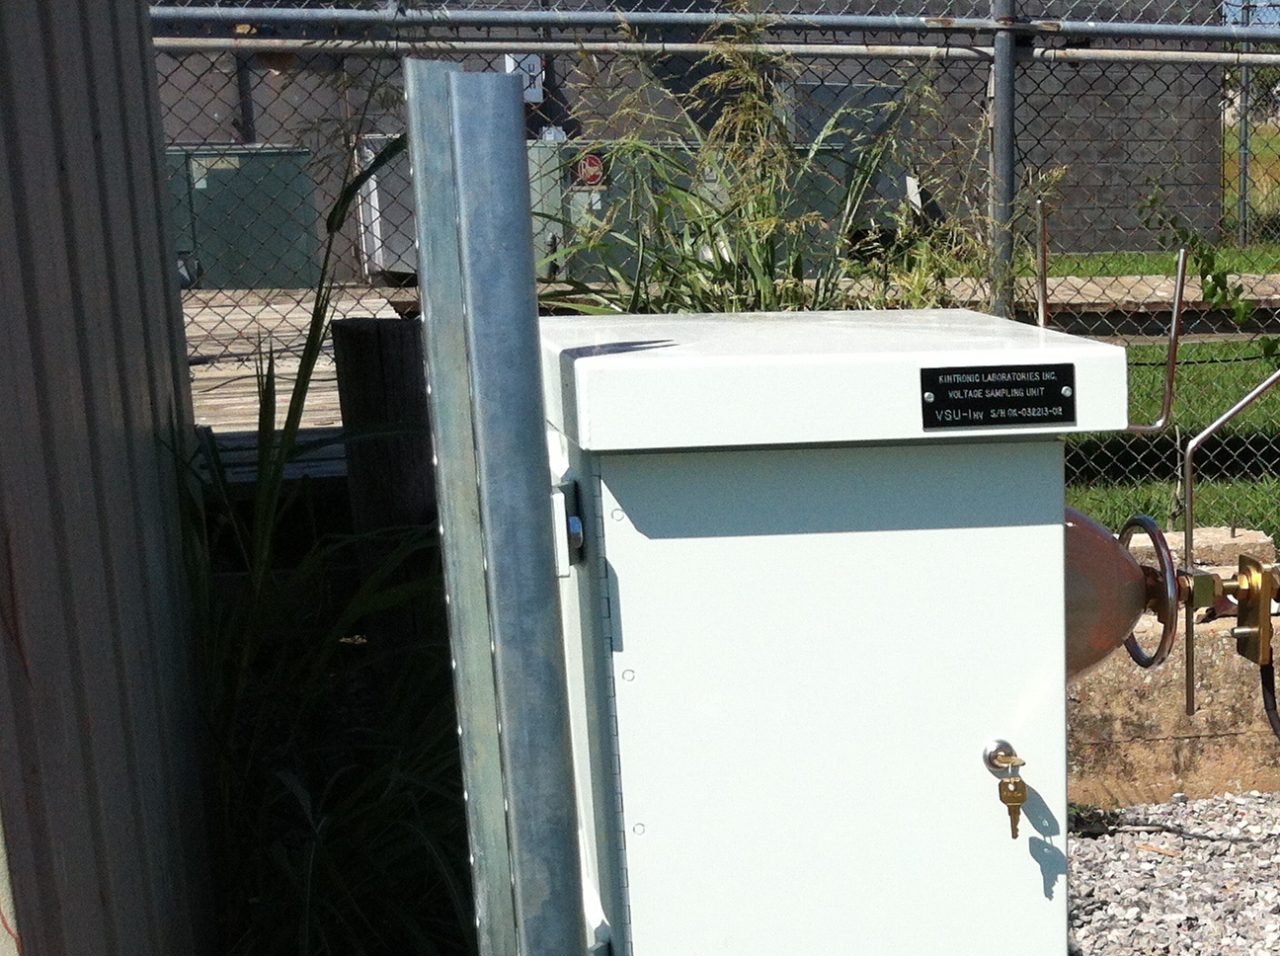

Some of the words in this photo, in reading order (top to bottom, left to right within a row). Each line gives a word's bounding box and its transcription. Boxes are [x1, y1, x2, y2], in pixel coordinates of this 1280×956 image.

[938, 374, 980, 384] KINTRONIC
[982, 372, 1040, 383] LABORATORIES
[948, 389, 983, 399] VOLTAGE
[985, 388, 1025, 398] SAMPLING
[1026, 387, 1045, 397] UNIT
